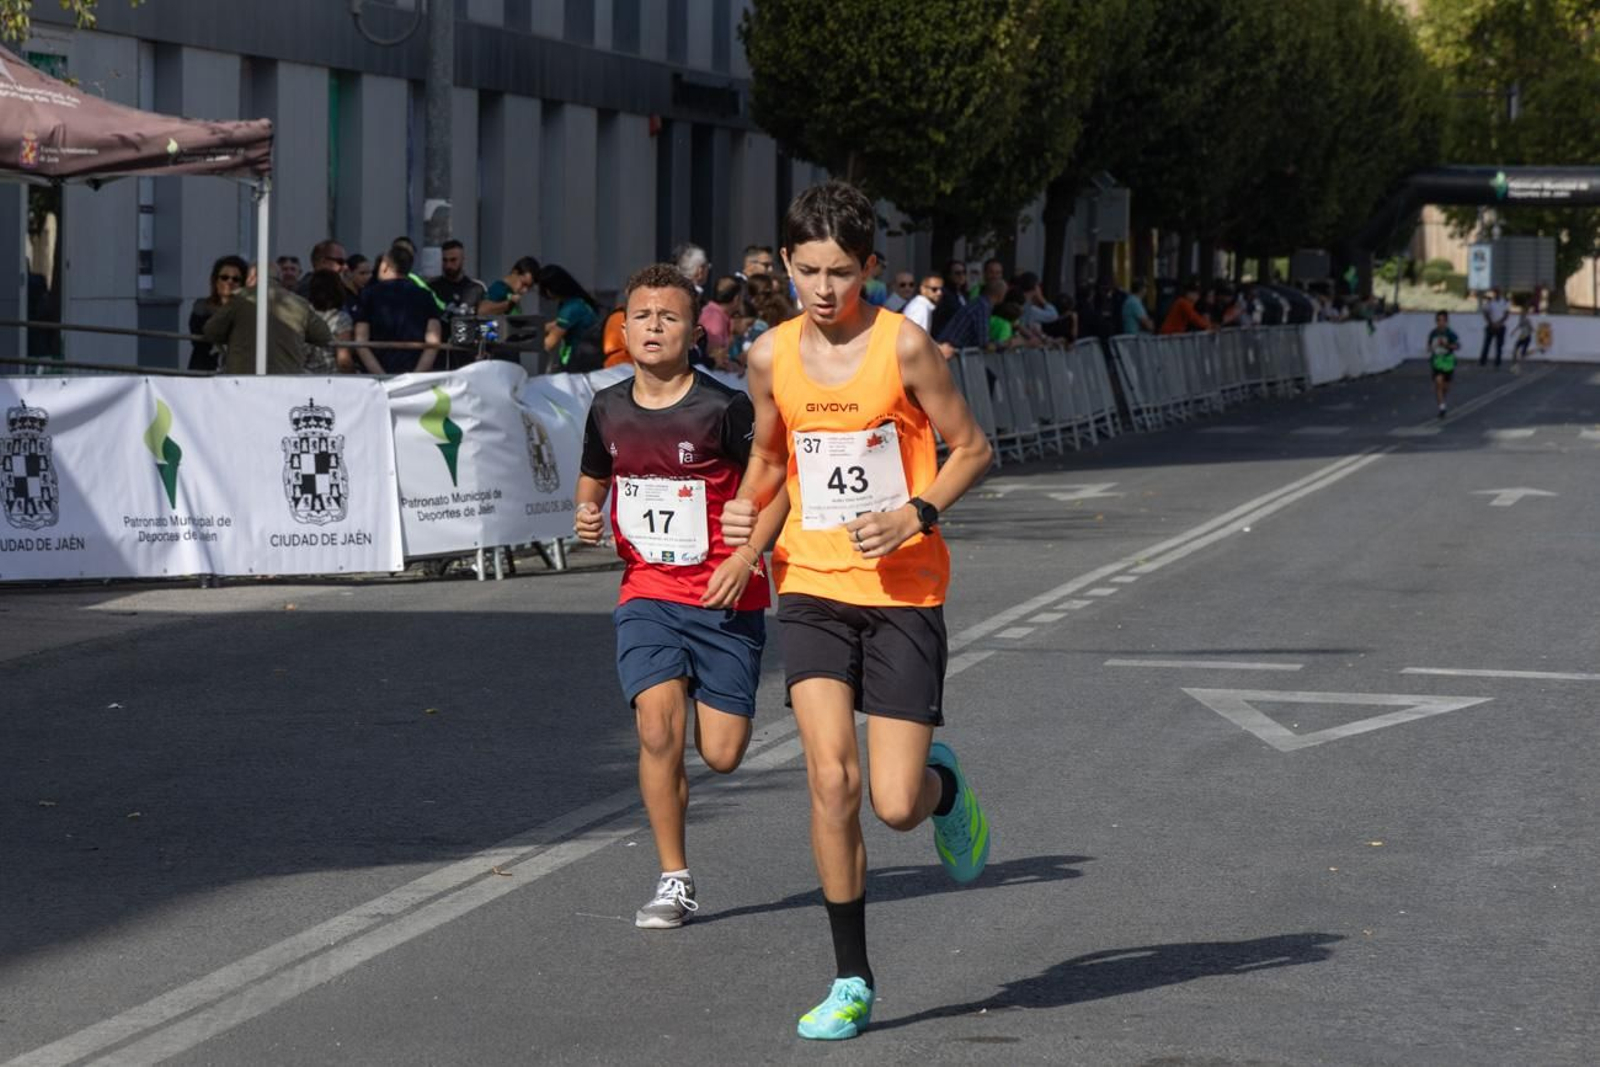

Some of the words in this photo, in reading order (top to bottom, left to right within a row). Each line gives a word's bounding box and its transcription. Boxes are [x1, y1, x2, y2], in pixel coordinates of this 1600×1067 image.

[806, 403, 859, 412] GIVOVA
[803, 438, 821, 453] 37
[827, 466, 869, 494] 43
[625, 482, 639, 497] 37
[400, 495, 450, 508] Patronato
[170, 515, 214, 528] Munipal
[217, 514, 232, 527] de
[417, 509, 461, 522] Deportes
[463, 506, 475, 517] de
[643, 509, 675, 534] 17
[36, 538, 52, 551] DE
[54, 534, 85, 551] JAÉN
[138, 531, 180, 543] Deportes
[183, 529, 198, 541] de
[199, 532, 218, 542] aén
[270, 534, 318, 547] CIUDAD
[321, 533, 337, 546] DE
[340, 529, 372, 546] JAÉN
